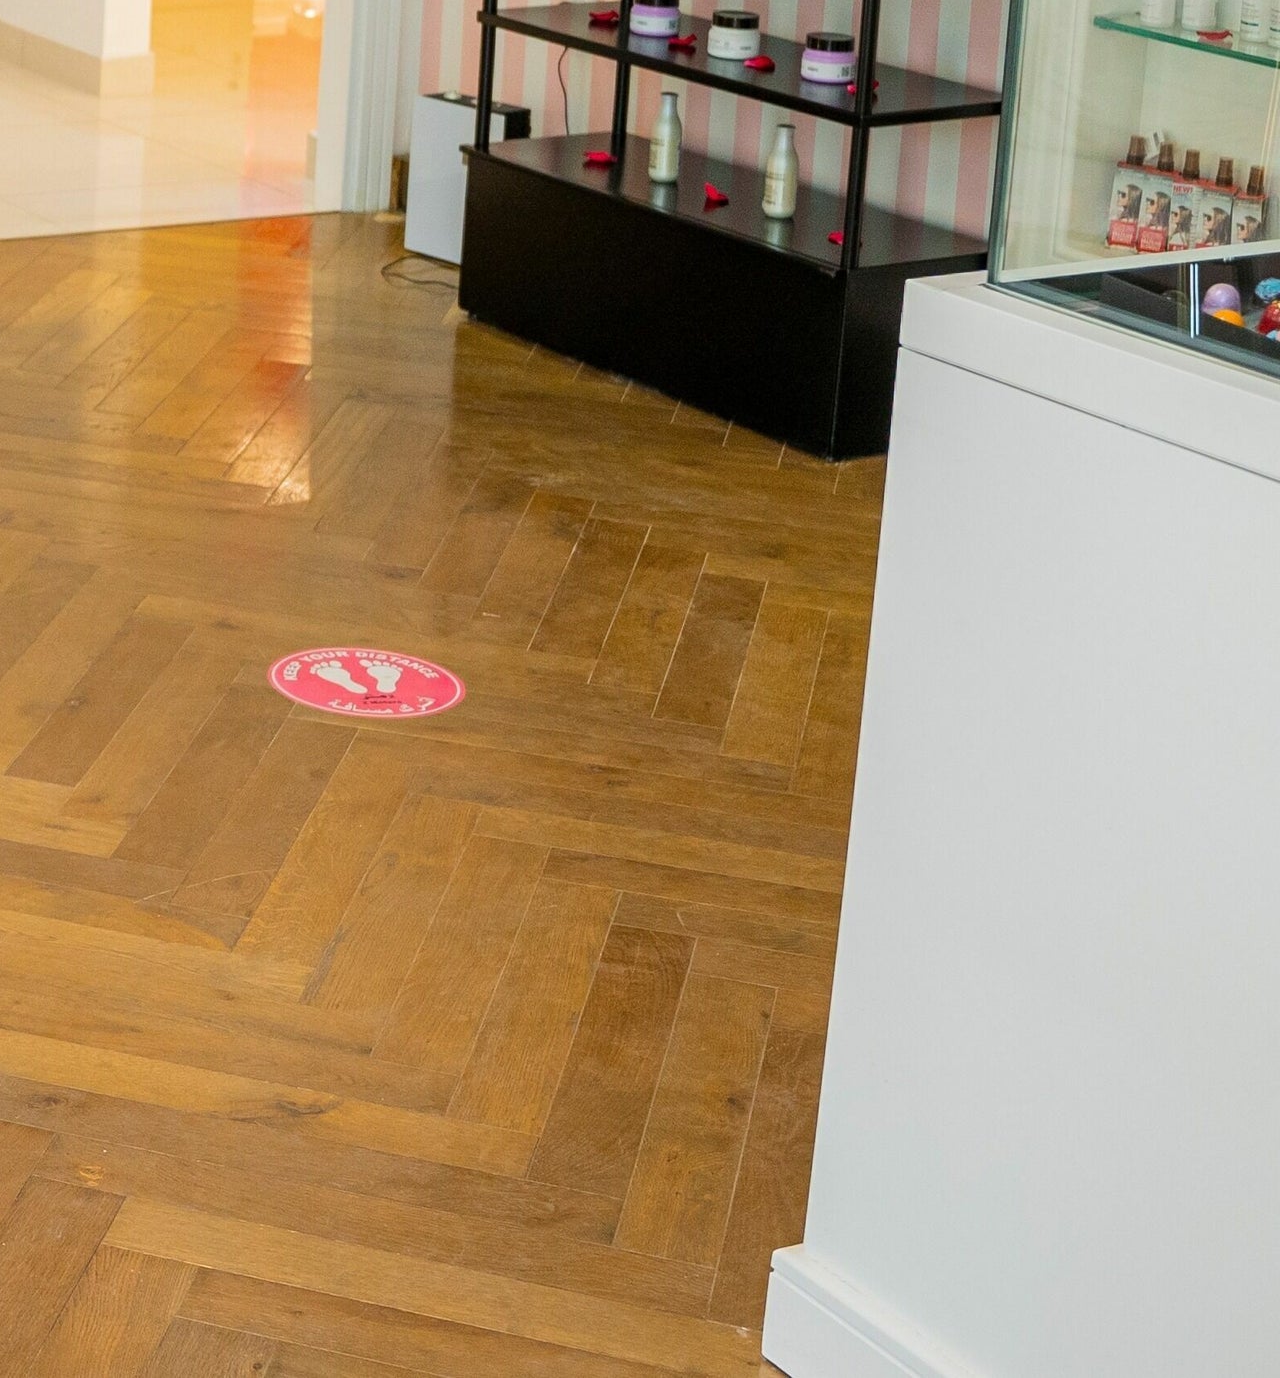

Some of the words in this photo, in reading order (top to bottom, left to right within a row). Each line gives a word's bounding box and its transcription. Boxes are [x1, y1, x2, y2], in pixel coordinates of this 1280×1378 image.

[283, 660, 301, 681] KEEP
[298, 651, 350, 662] YOUR
[355, 651, 439, 678] DISTANCE
